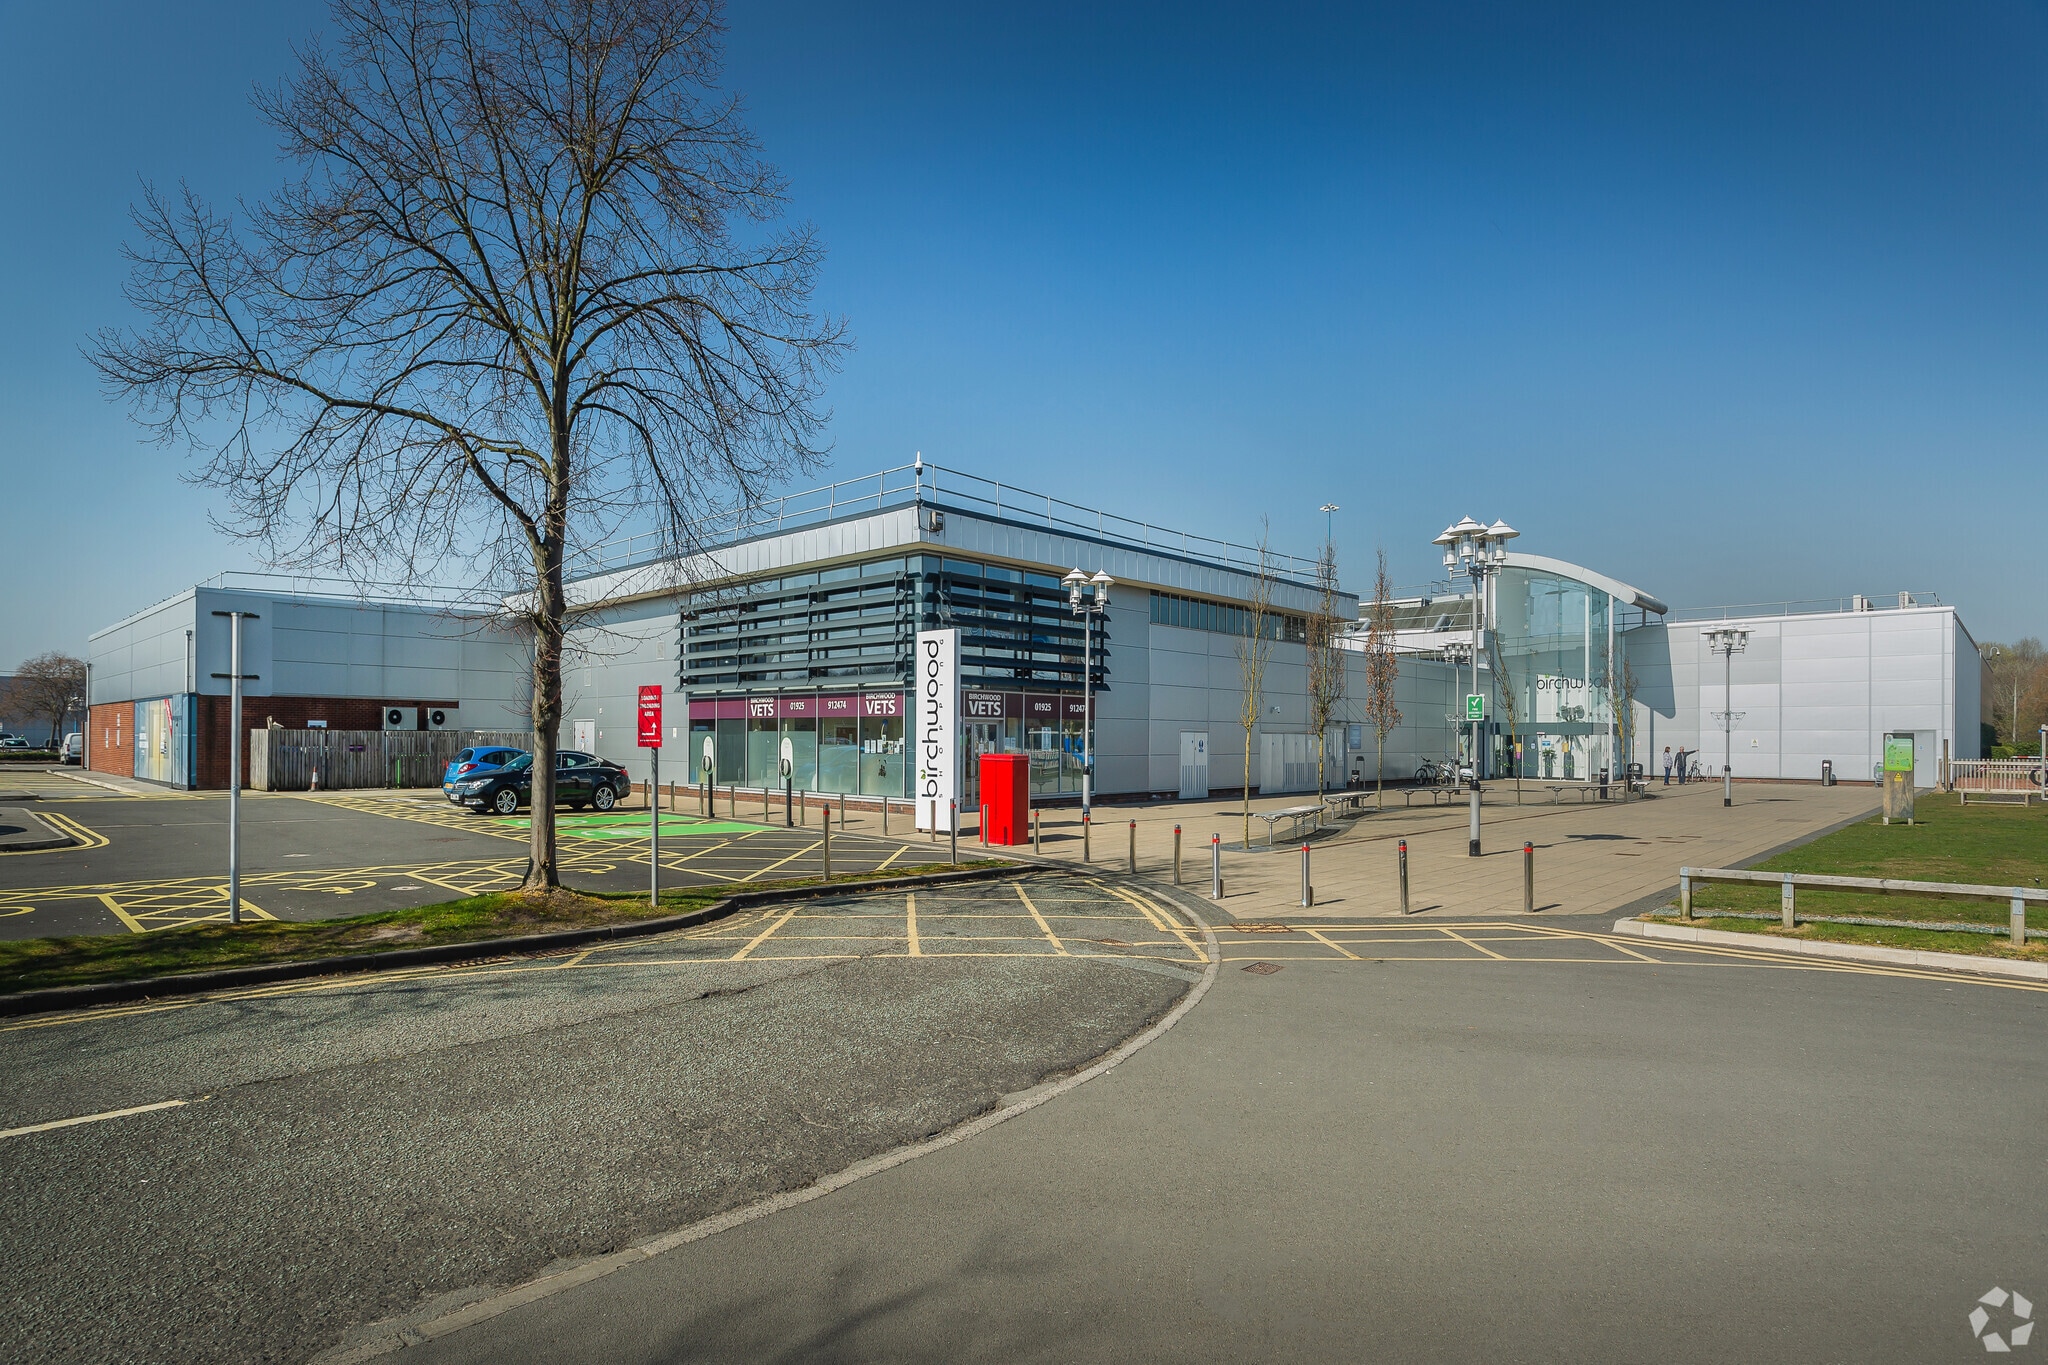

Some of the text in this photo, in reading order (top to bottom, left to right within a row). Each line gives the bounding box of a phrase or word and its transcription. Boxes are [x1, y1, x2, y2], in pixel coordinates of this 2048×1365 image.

[750, 704, 774, 716] VETS
[790, 700, 847, 710] 01925 912474
[866, 700, 896, 714] VETS
[968, 701, 1002, 716] VETS
[1034, 703, 1086, 712] 01925 91247
[921, 640, 938, 798] birchwood
